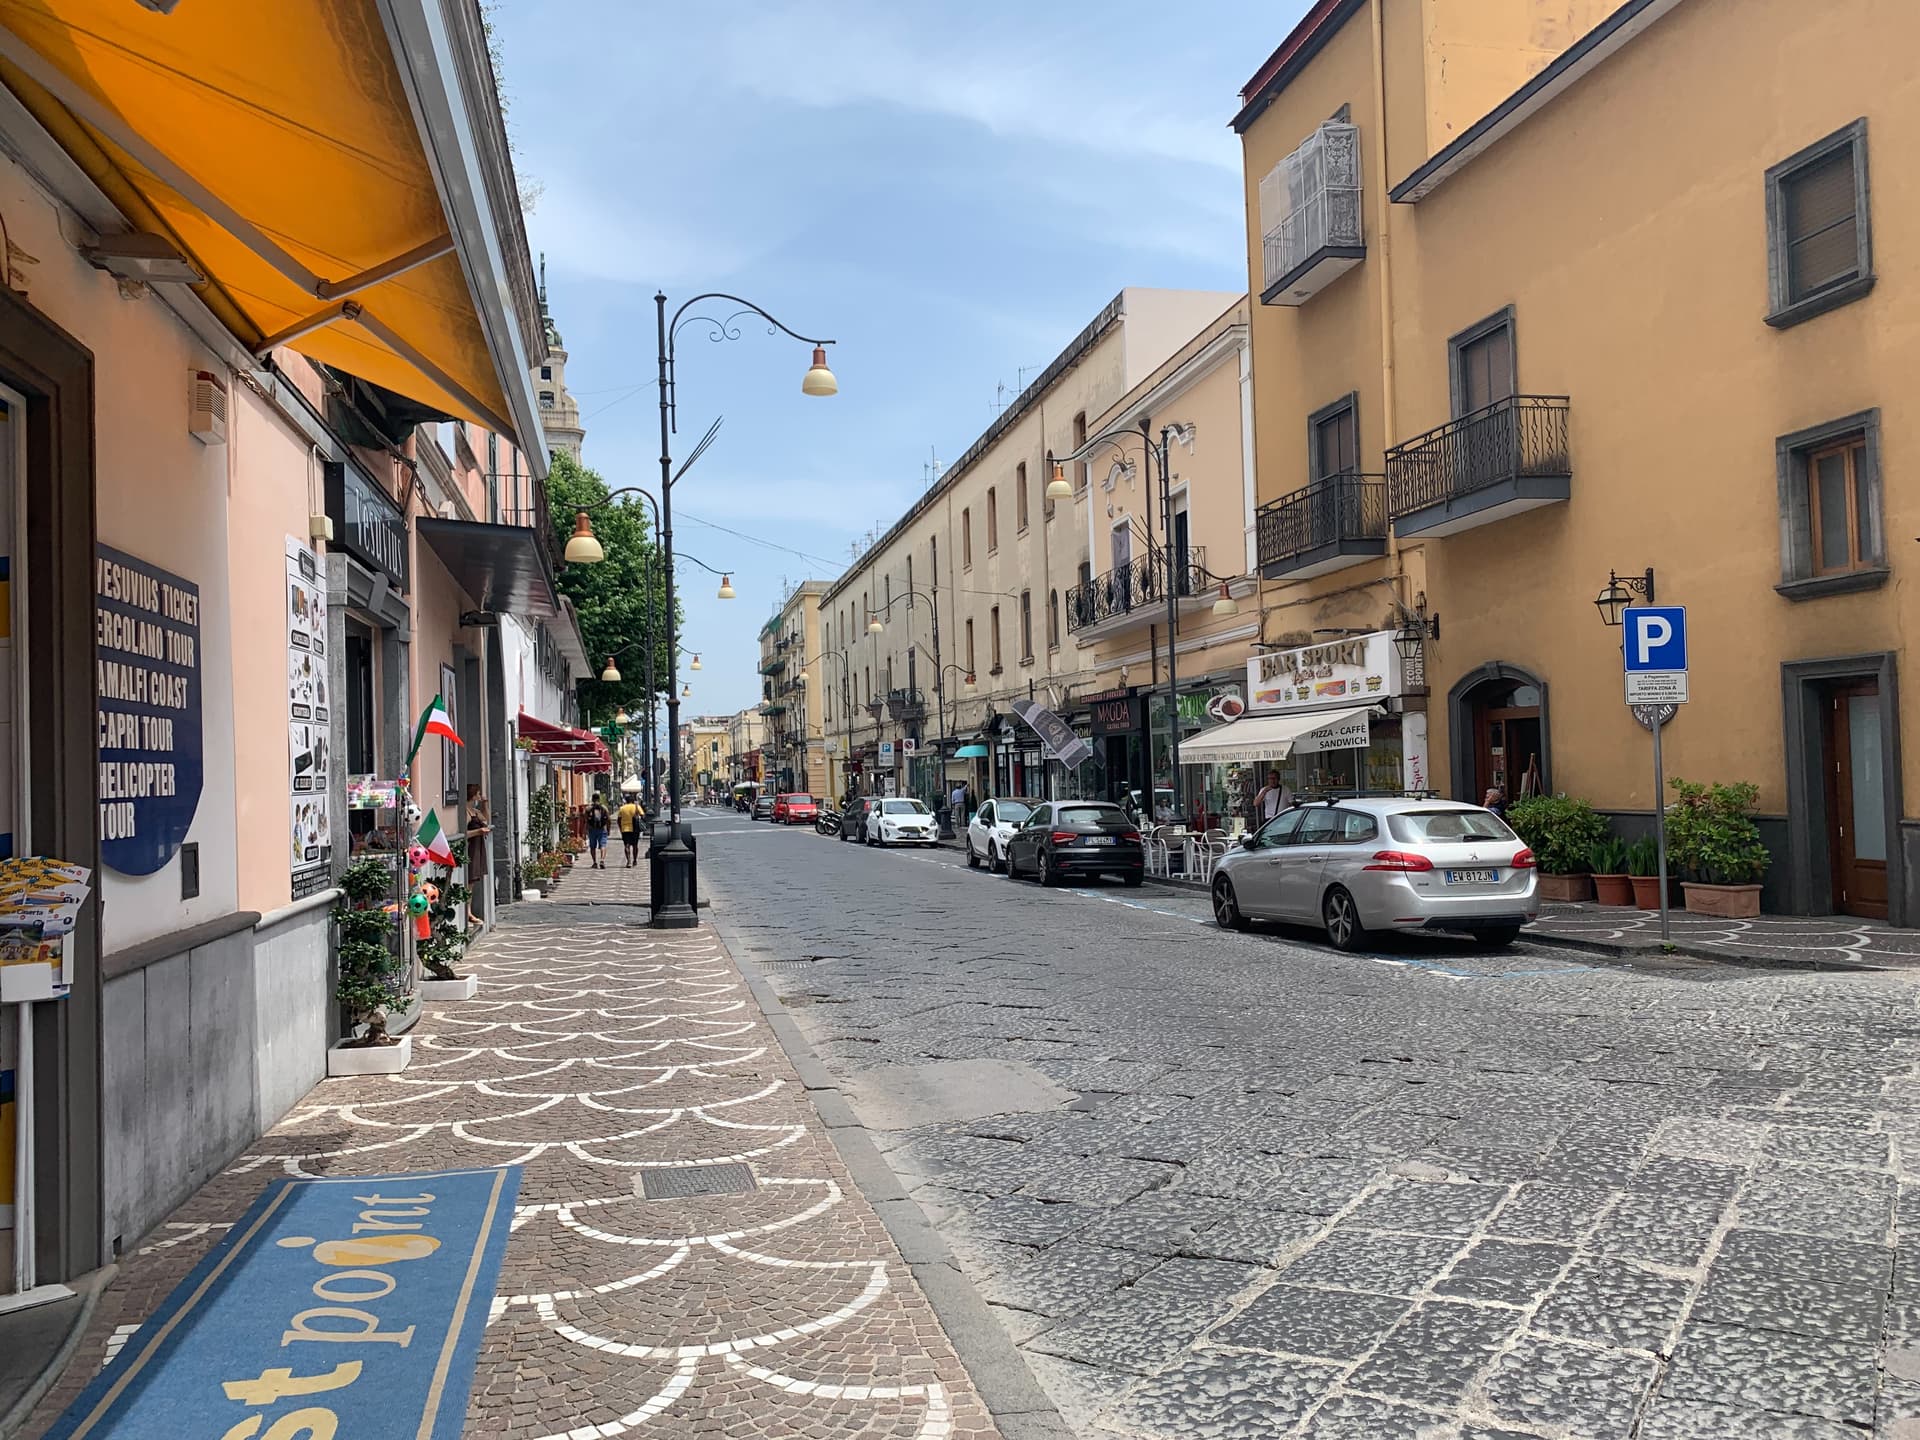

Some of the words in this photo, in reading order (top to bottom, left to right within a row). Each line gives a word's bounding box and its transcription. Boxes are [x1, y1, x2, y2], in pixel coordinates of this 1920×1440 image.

[162, 583, 198, 627] TICKET
[98, 608, 164, 660] ERCOLANO
[167, 629, 194, 668] TOUR
[1637, 615, 1673, 664] P
[1259, 652, 1298, 683] BAR
[1302, 639, 1369, 668] SPORT
[98, 659, 148, 703] AMALFI
[151, 671, 188, 710] COAST
[98, 710, 140, 750] CAPRI
[142, 715, 174, 752] TOUR
[1097, 700, 1130, 723] MAGDA
[1311, 729, 1334, 739] PIZZA
[1340, 723, 1367, 735] CAFFÈ
[1320, 736, 1367, 749] SANDWICH
[100, 762, 175, 799] HELICOPTER
[100, 802, 135, 841] TOUR
[17, 908, 44, 916] Caserta
